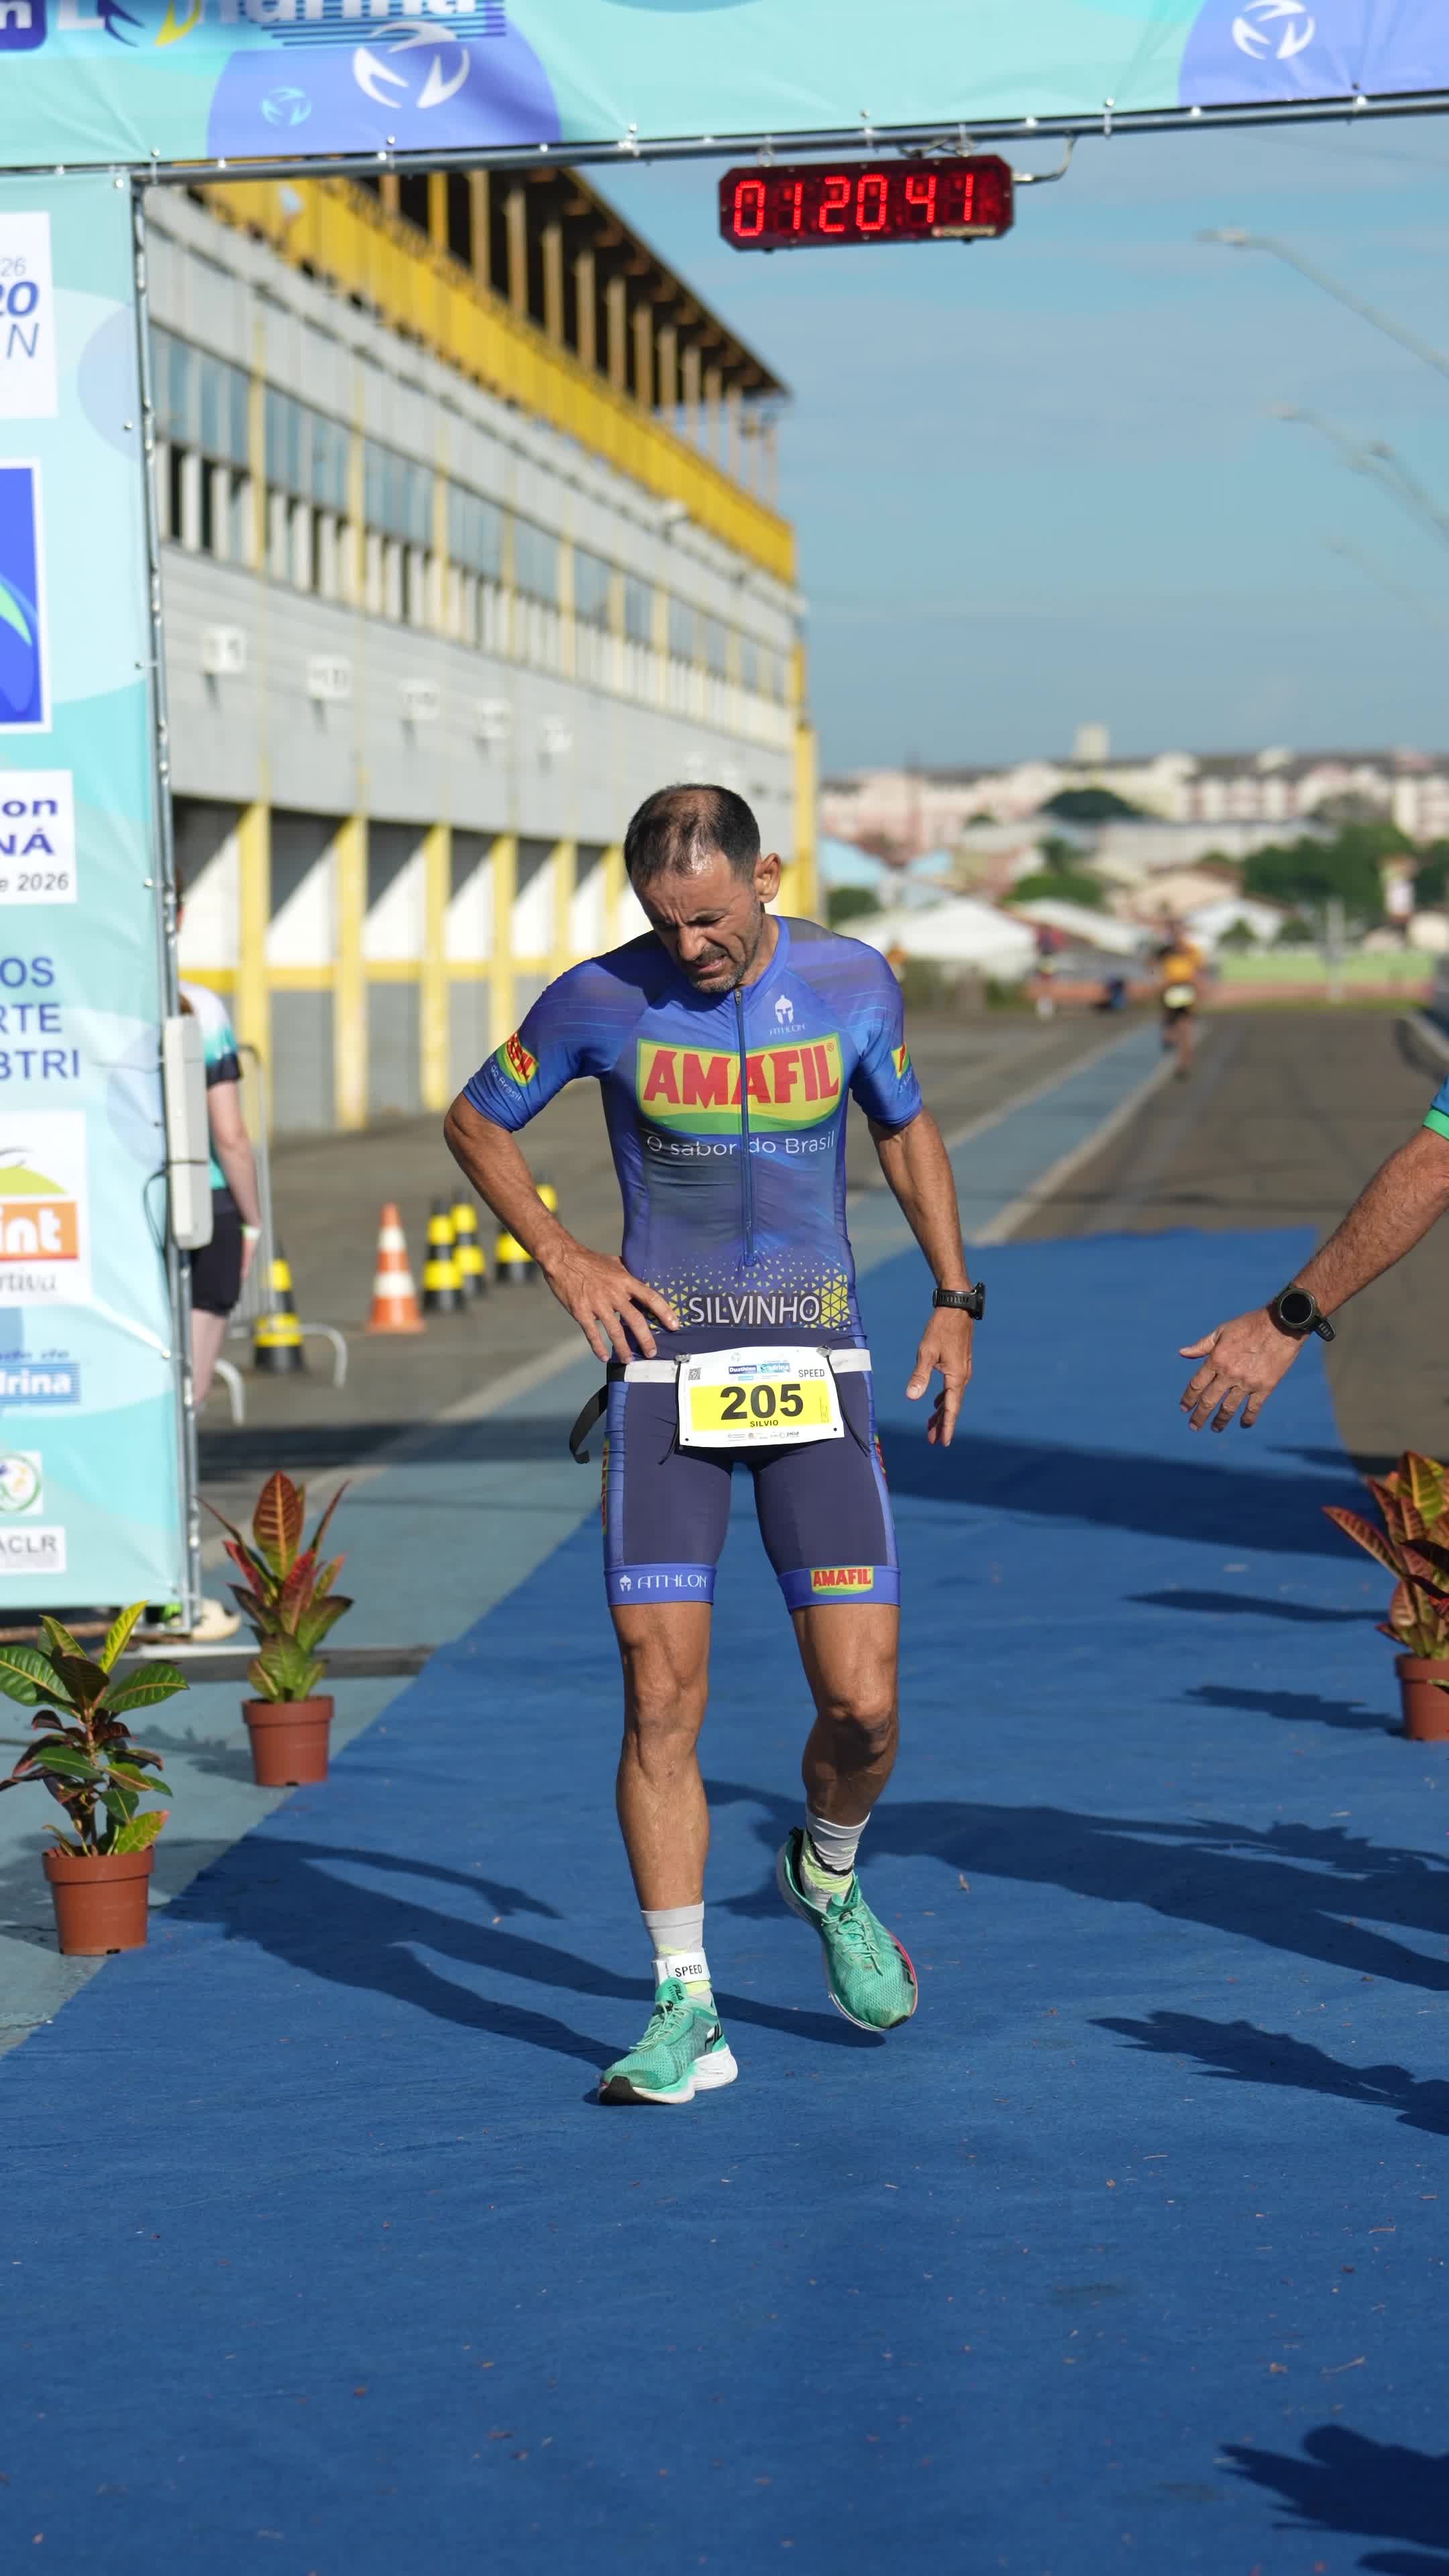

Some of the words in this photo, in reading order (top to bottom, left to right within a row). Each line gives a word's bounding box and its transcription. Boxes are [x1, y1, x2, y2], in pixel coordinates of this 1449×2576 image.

[17, 873, 68, 891] 2026
[647, 1136, 662, 1152] O
[670, 1140, 736, 1157] sabor
[749, 1137, 777, 1153] do
[785, 1130, 836, 1155] Brasil
[0, 1208, 62, 1252] nt
[688, 1295, 820, 1325] SILVINHO
[798, 1369, 825, 1378] SPEED
[720, 1383, 804, 1421] 205
[749, 1419, 779, 1428] SILVIO
[637, 1574, 707, 1589] ATHLON
[812, 1568, 872, 1588] AMAFIL
[675, 1964, 702, 1978] SPEED
[672, 1984, 684, 2001] FILA
